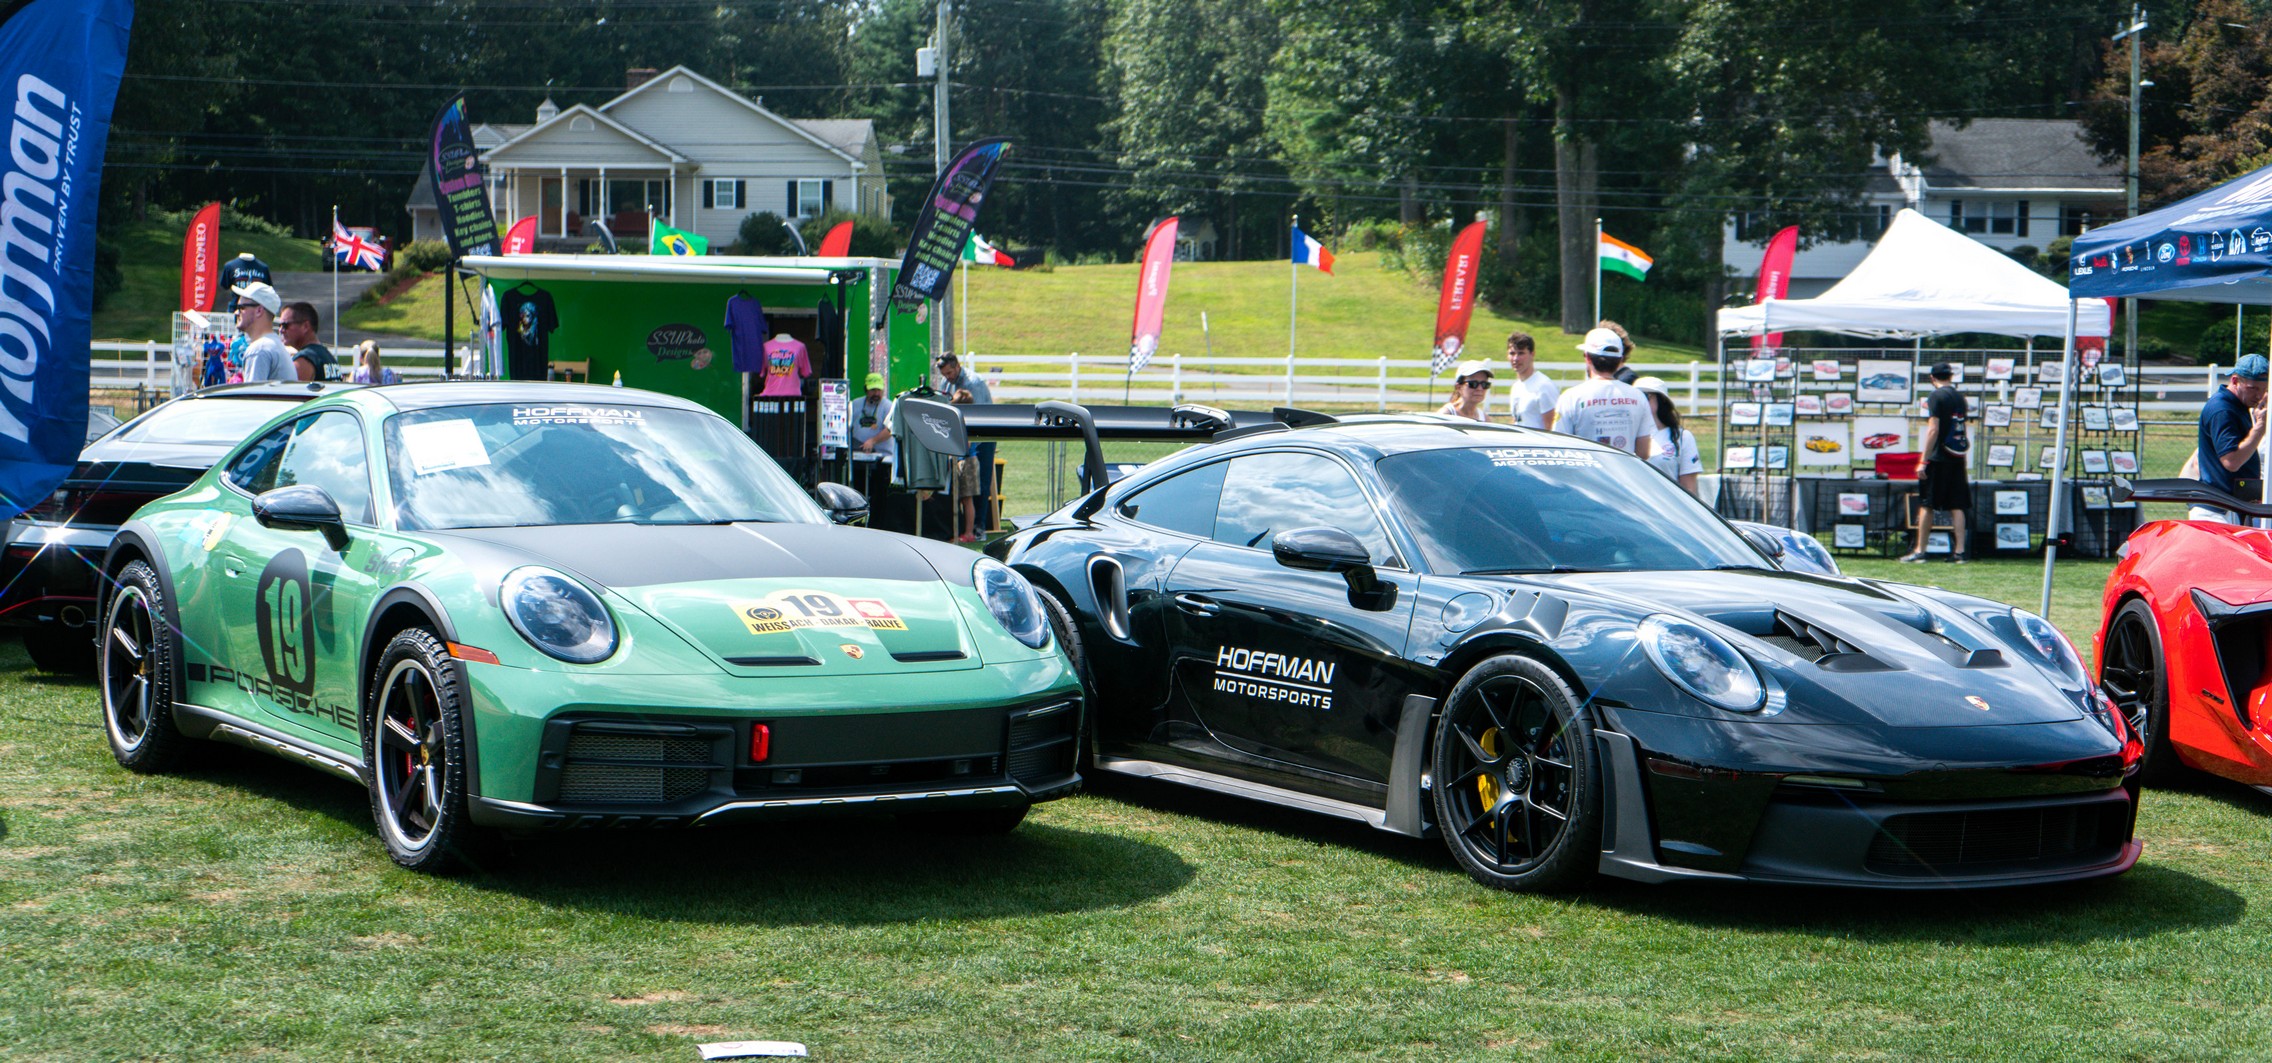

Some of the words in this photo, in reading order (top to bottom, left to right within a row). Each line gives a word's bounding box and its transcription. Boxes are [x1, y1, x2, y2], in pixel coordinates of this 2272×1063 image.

[66, 101, 83, 167] TRUST
[61, 167, 72, 198] BY
[53, 198, 68, 276] DRIVEN
[513, 408, 641, 418] HOFFMAN
[1592, 398, 1607, 407] PIT
[1611, 397, 1638, 406] CREW
[514, 418, 647, 426] MOTORSPORTS
[1486, 449, 1594, 460] HOFFMAN
[1493, 460, 1602, 468] MOTORSPORTS
[781, 594, 843, 617] 19
[264, 576, 306, 684] 19
[752, 619, 813, 632] WEISSACH
[820, 618, 859, 627] DAKAR
[865, 619, 902, 629] RALLYE
[1217, 645, 1335, 684] HOFFMAN
[209, 665, 358, 732] PORSCHE
[1214, 678, 1331, 709] MOTORSPORTS
